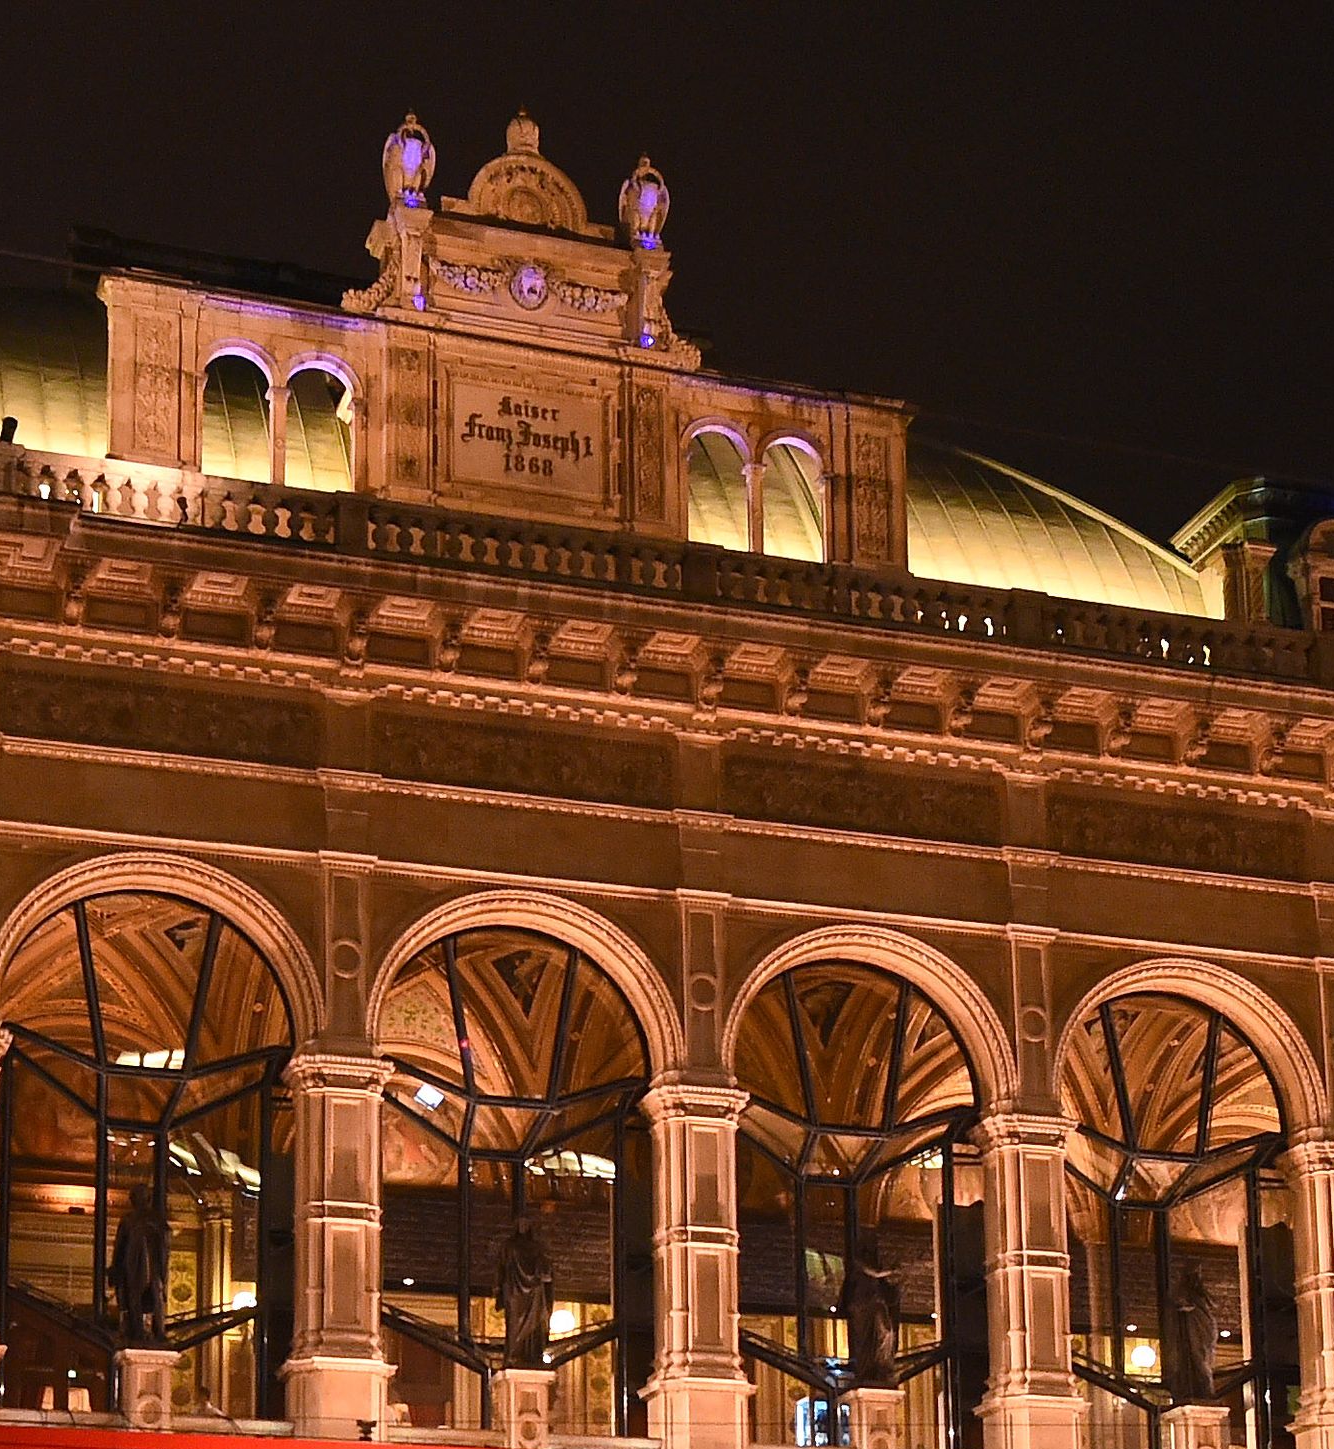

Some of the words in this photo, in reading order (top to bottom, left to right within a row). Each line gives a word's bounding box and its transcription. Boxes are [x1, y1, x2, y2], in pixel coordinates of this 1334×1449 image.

[498, 396, 560, 422] Kaiser
[461, 413, 514, 451] Franz
[517, 420, 580, 461] Joseph
[503, 452, 554, 477] 1868
